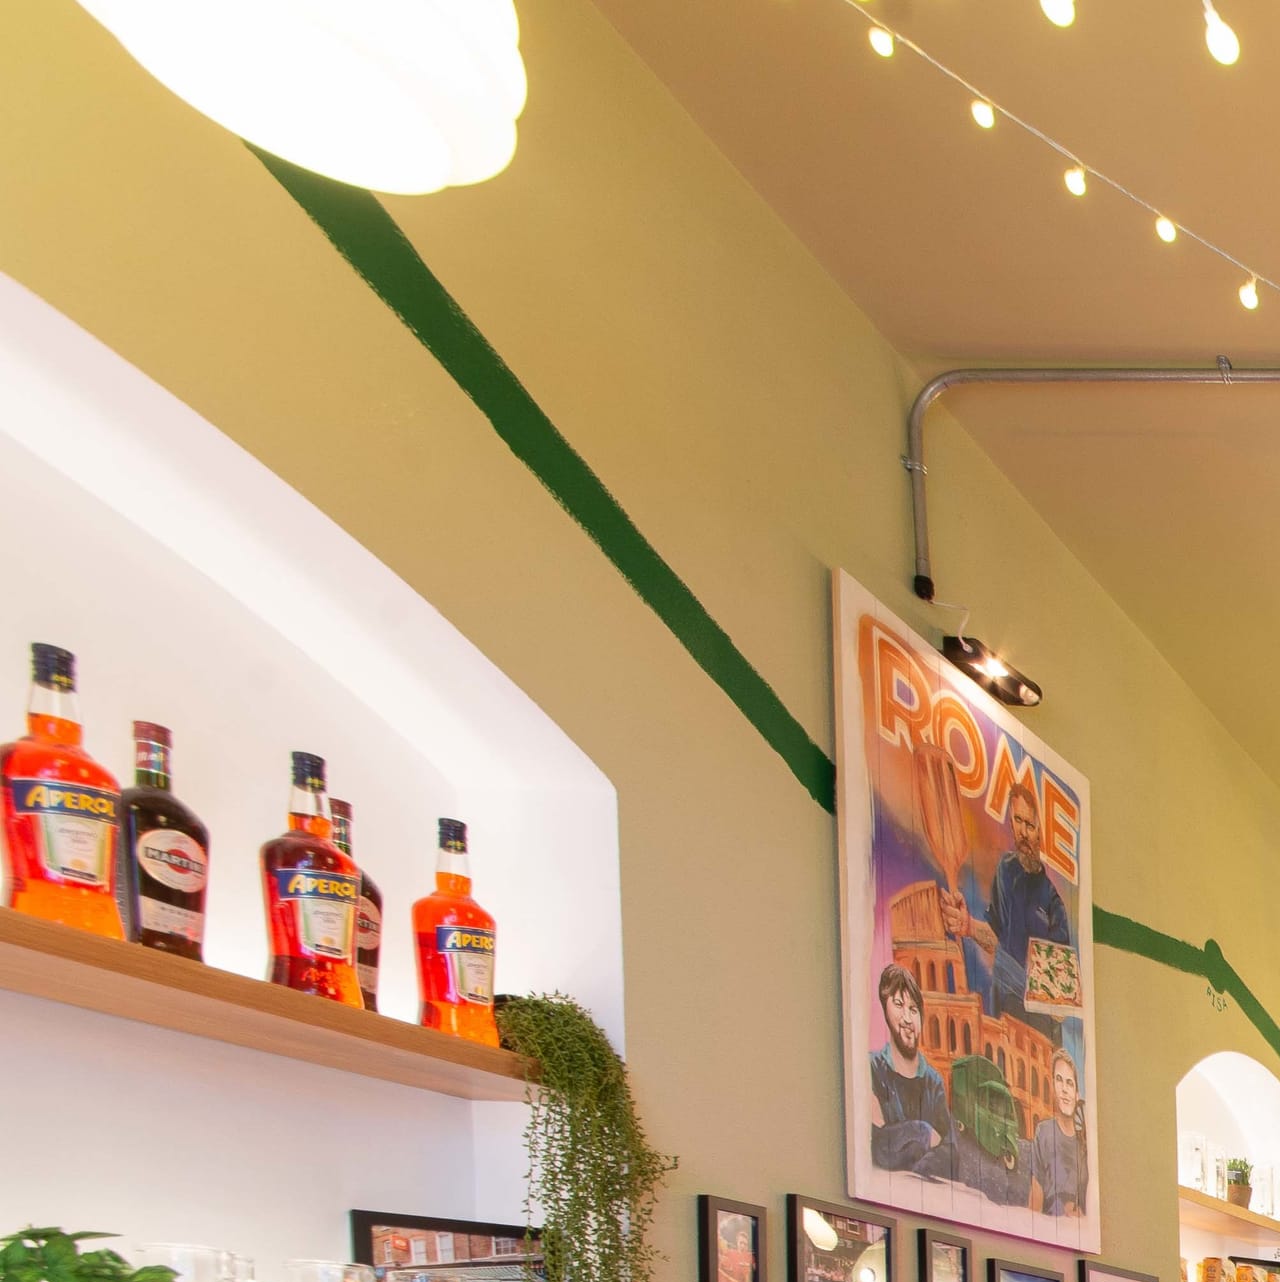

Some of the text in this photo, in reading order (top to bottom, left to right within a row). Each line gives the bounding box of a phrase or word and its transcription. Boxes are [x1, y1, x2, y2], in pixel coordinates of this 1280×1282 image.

[872, 624, 1081, 886] ROME
[25, 784, 117, 818] APEROL
[287, 874, 358, 899] APEROL
[1206, 986, 1228, 1012] PISA
